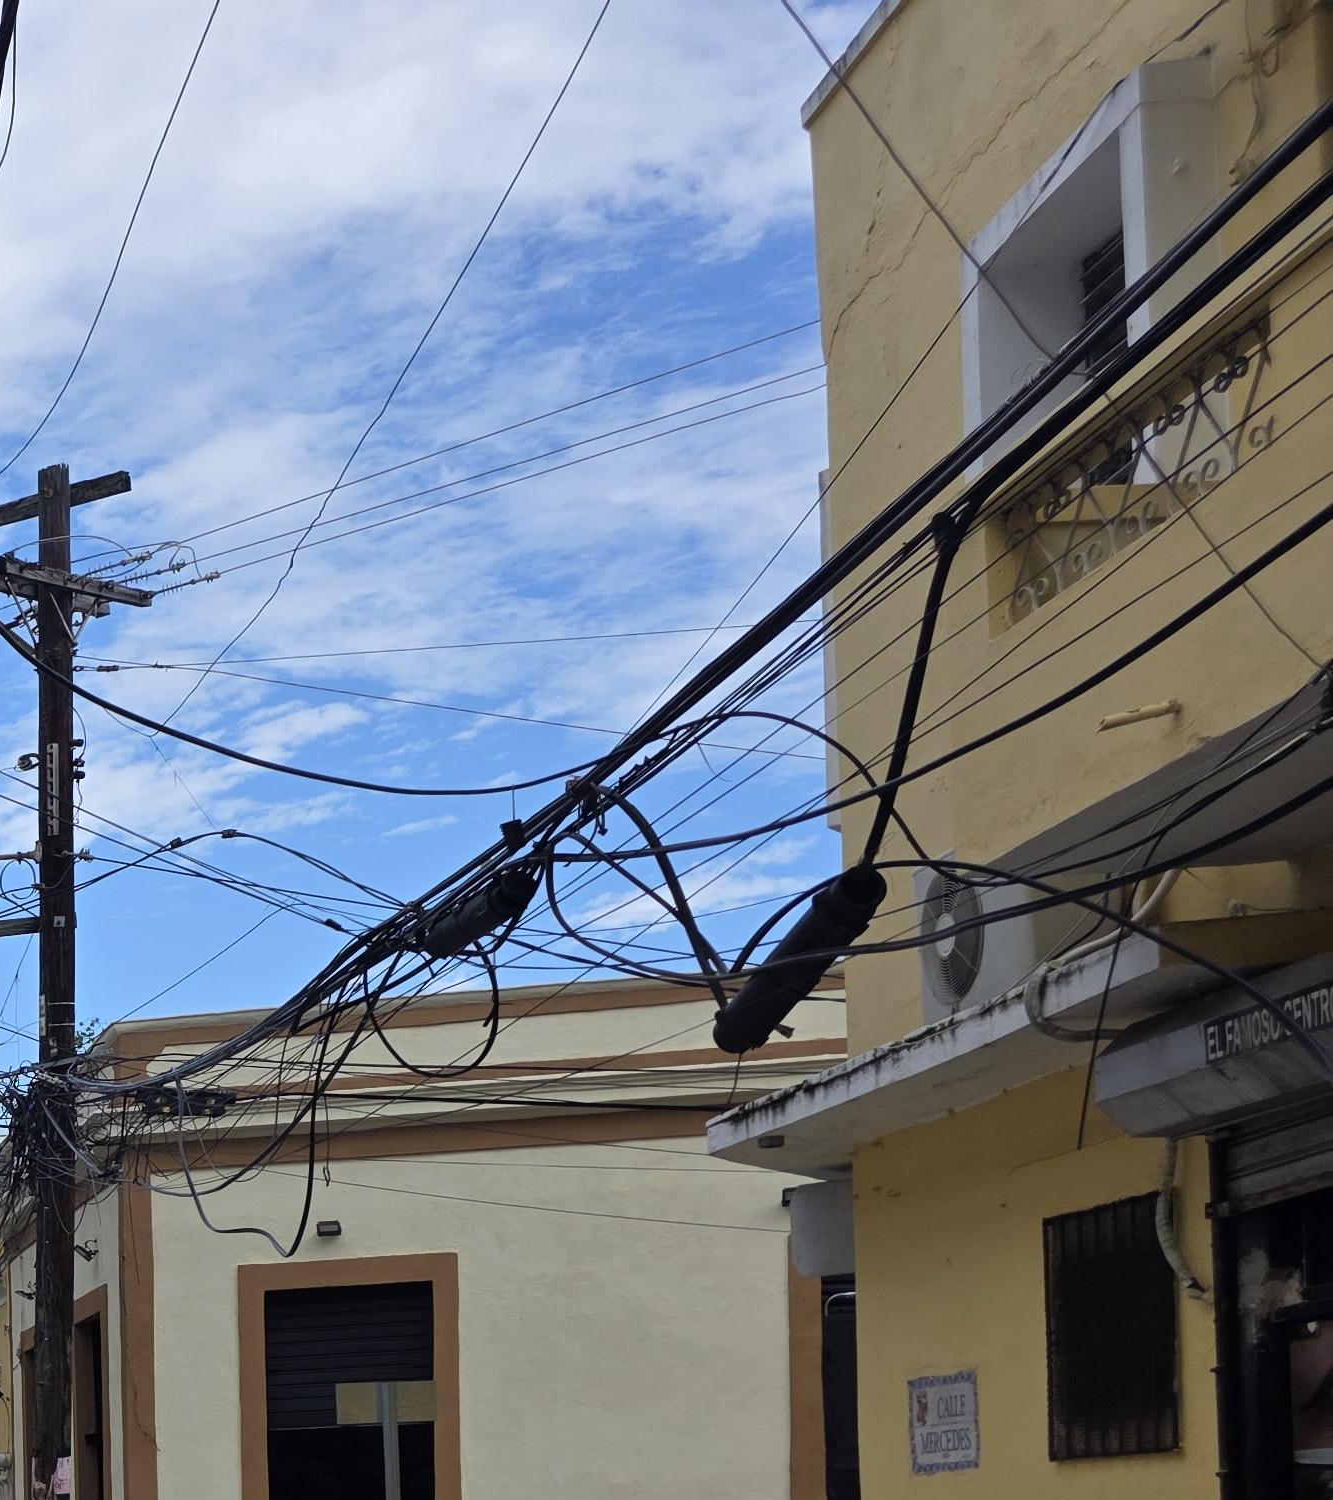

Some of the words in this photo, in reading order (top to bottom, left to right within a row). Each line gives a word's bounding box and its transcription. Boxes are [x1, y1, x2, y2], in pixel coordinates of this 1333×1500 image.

[1207, 1026, 1223, 1060] EL
[1225, 1008, 1281, 1056] FAMOSO
[1284, 987, 1333, 1036] CENTR
[937, 1394, 966, 1419] CALLE
[919, 1427, 972, 1455] MERCEDES
